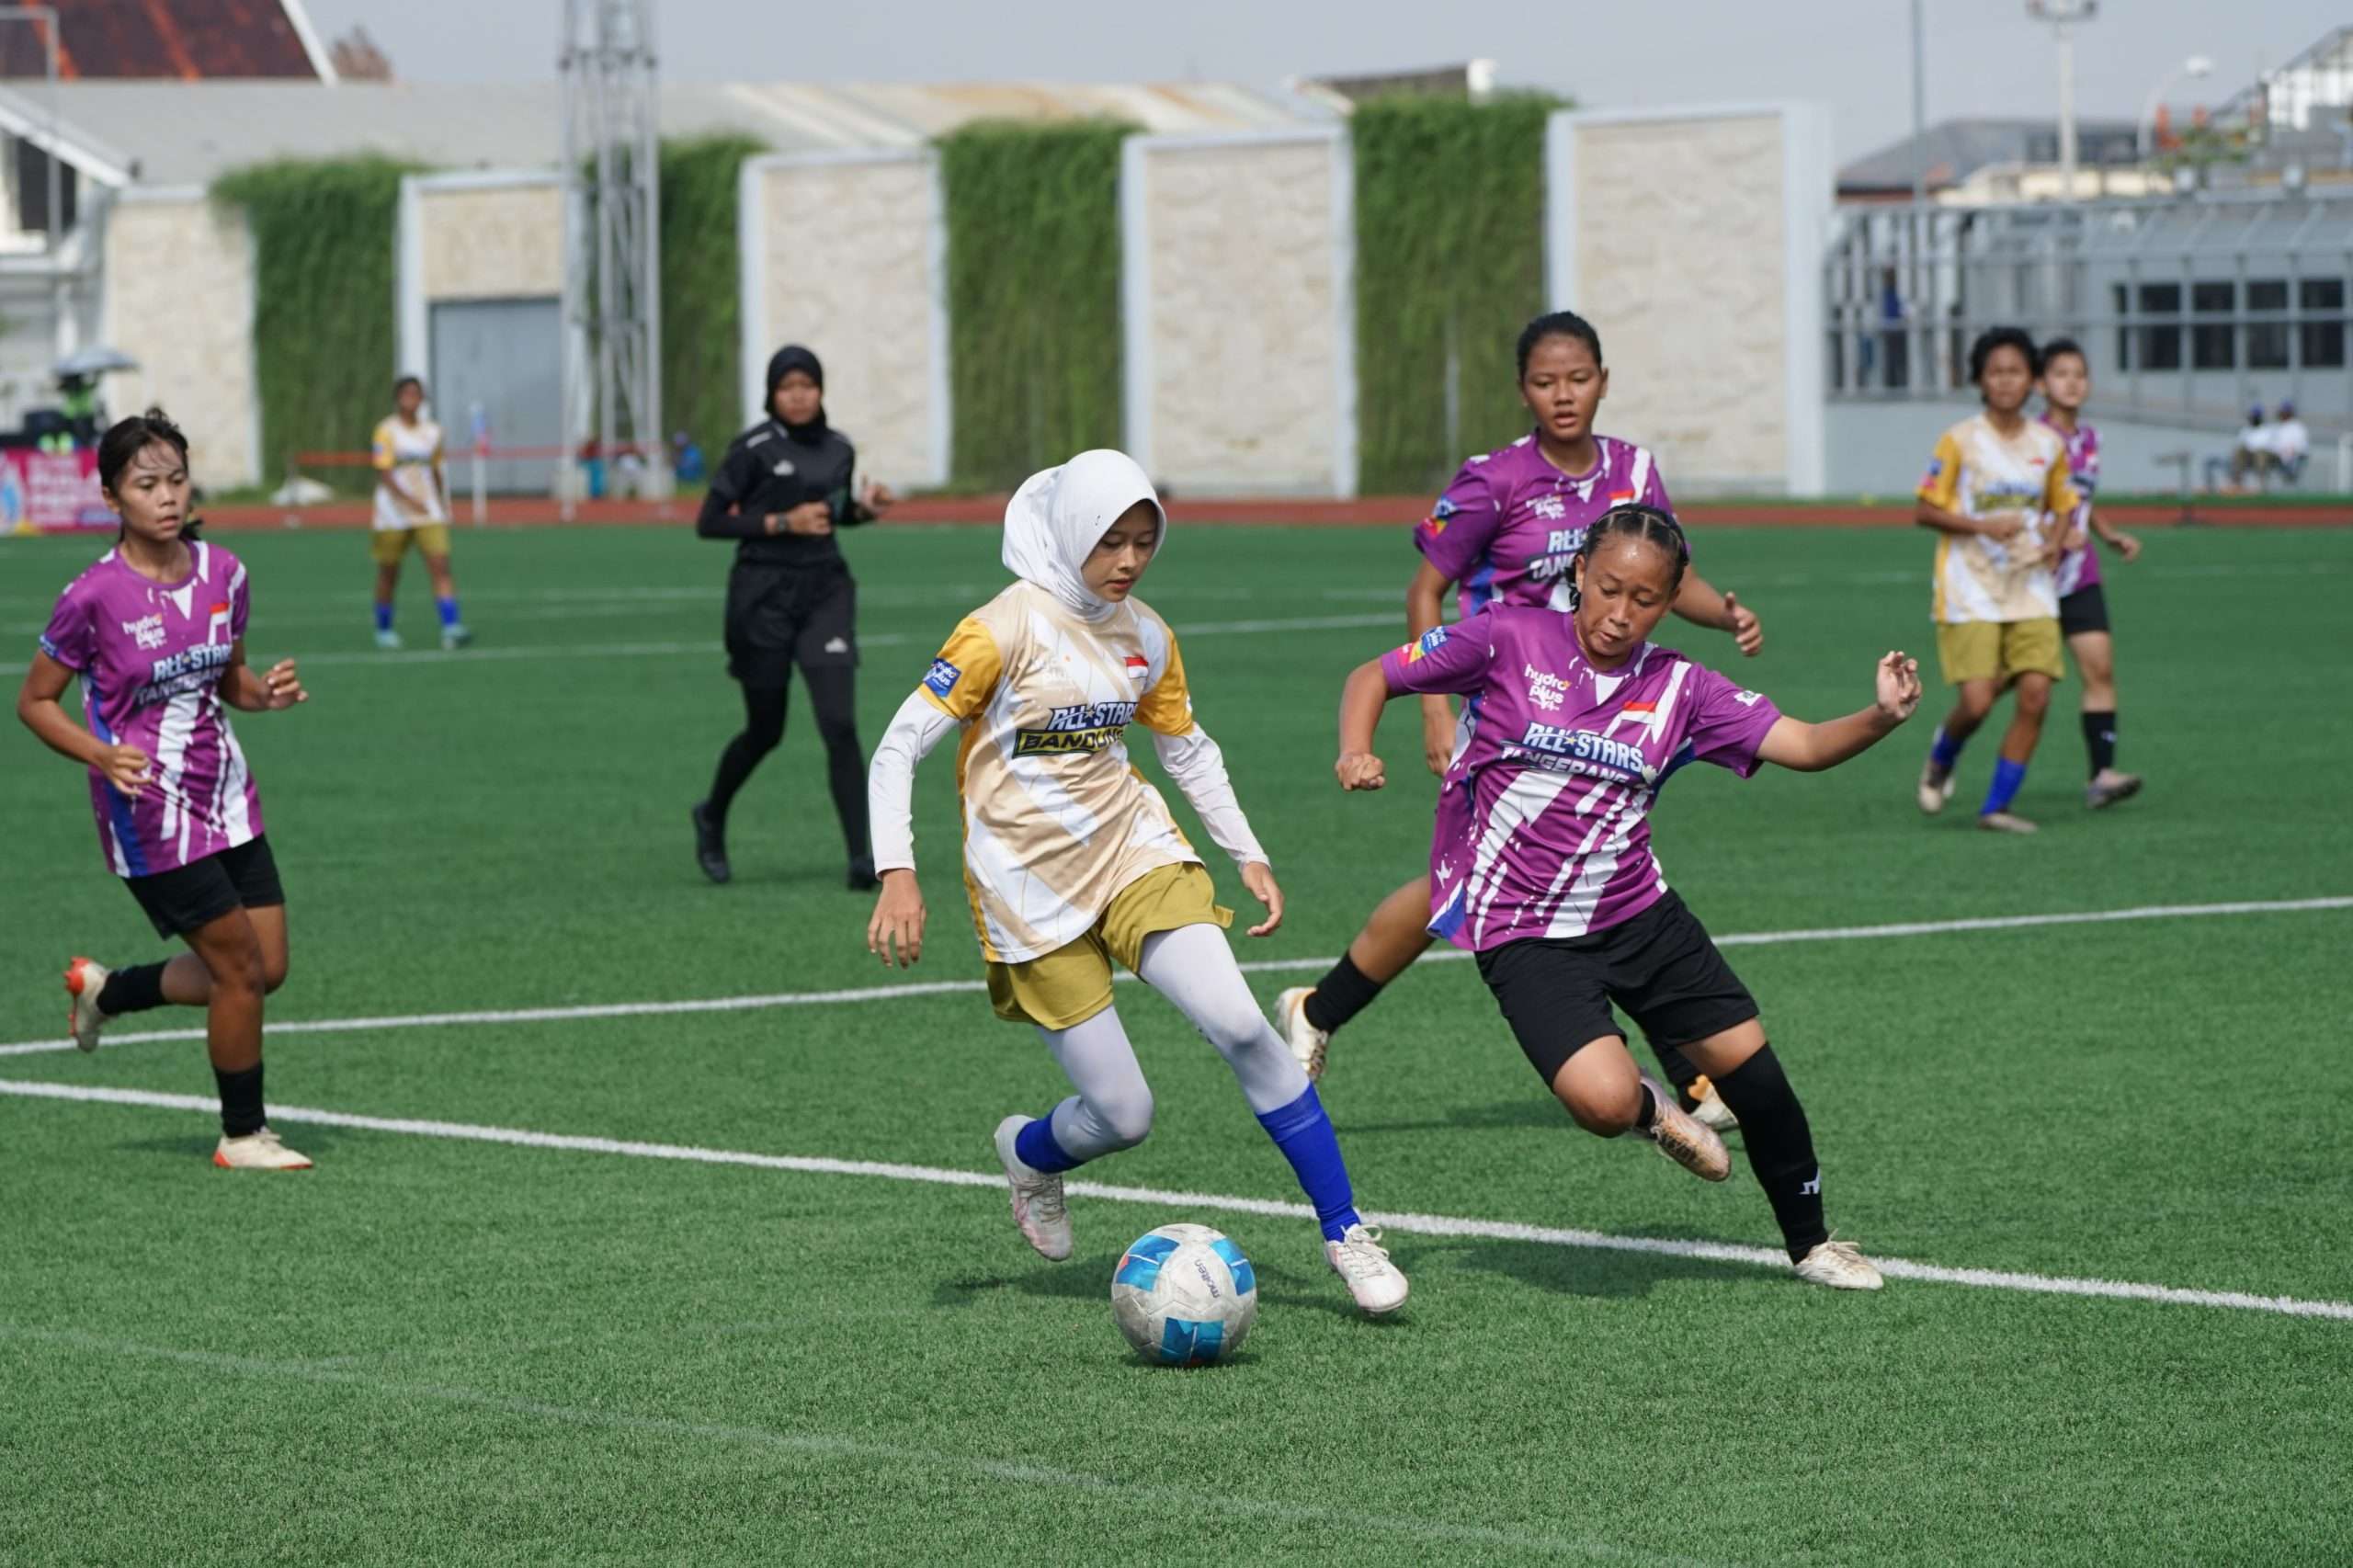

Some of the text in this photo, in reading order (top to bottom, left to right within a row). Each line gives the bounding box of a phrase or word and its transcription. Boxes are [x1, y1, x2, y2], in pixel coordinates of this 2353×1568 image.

[190, 644, 233, 670] STAR
[1524, 664, 1571, 690] hydro
[1529, 685, 1564, 704] plus
[1048, 702, 1137, 731] ALL STAR
[1522, 722, 1643, 773] ALL STARS
[1194, 1259, 1221, 1298] molten
